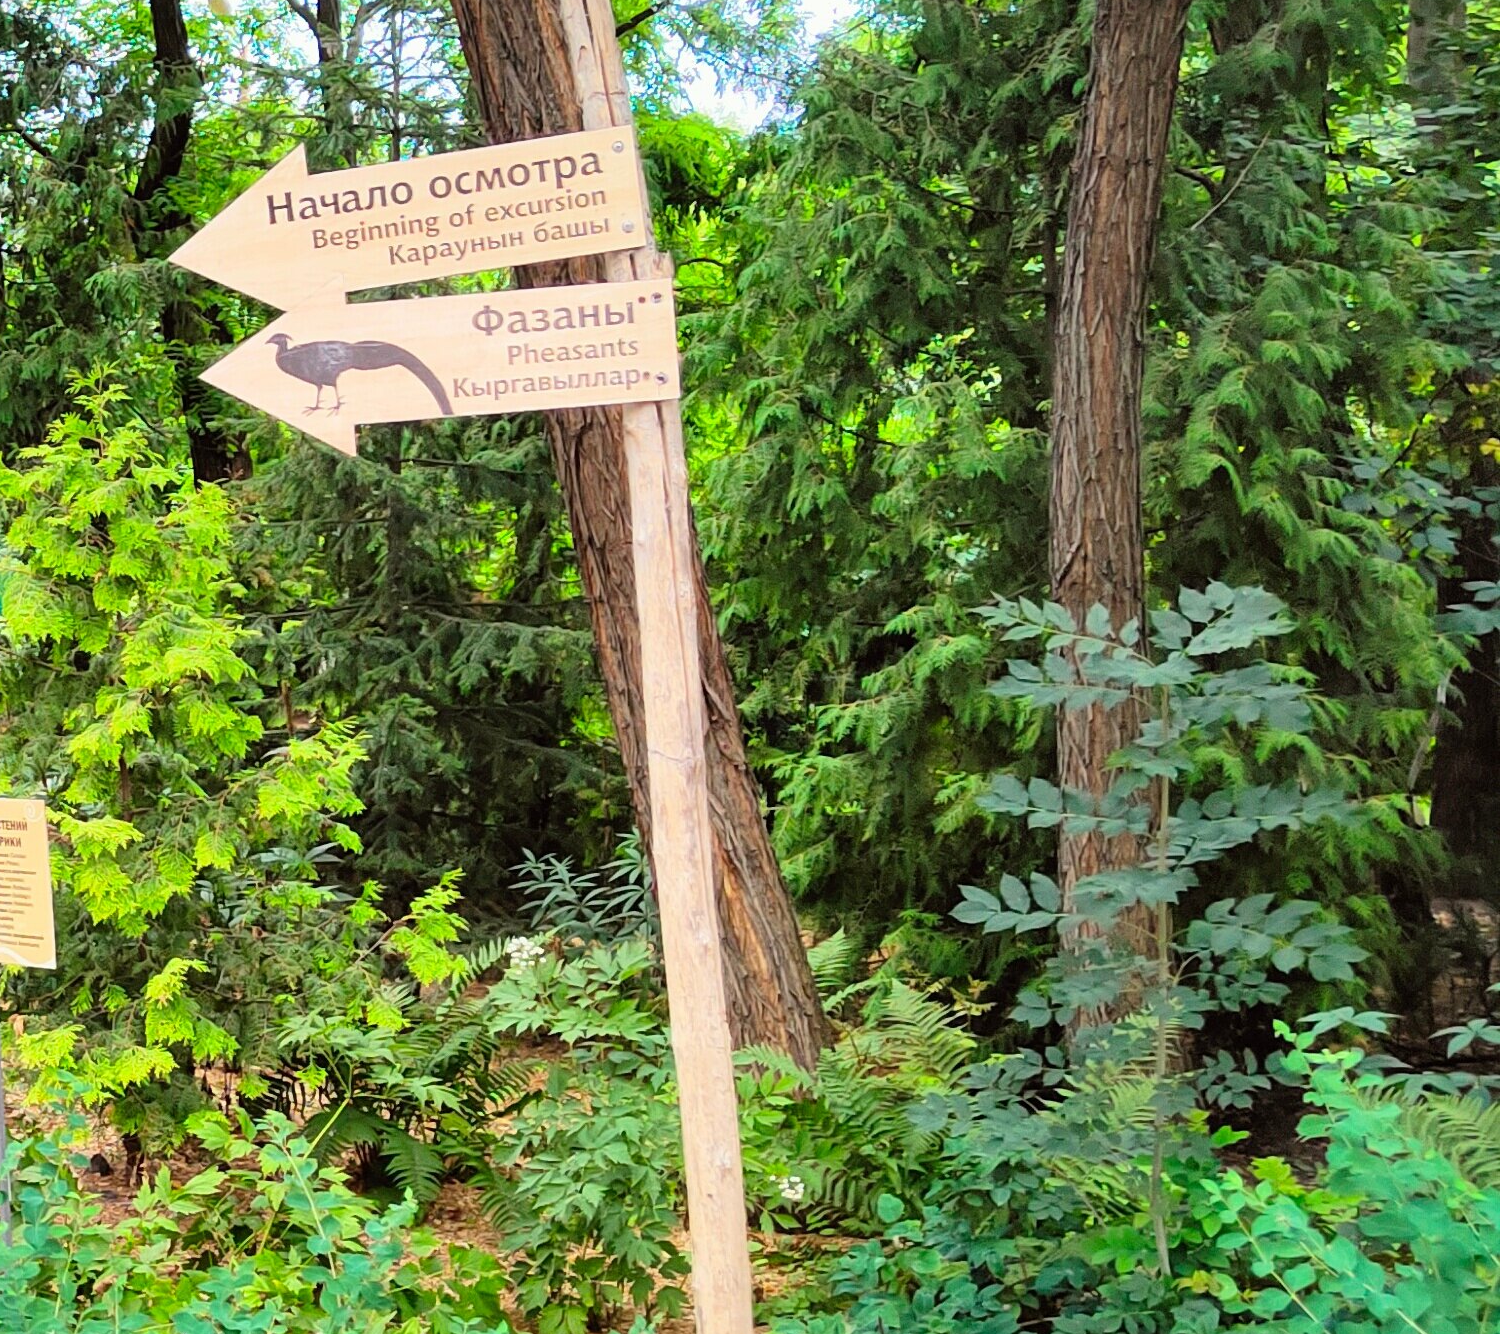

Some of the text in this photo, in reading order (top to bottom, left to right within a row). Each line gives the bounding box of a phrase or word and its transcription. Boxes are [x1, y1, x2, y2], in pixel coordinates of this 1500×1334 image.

[266, 152, 604, 225] Начало осмотра
[312, 188, 608, 250] Beginning of excursion
[388, 217, 610, 267] Караунын башы
[472, 301, 634, 335] Фазаны
[507, 336, 639, 365] Pheasants
[453, 369, 641, 399] Кыргавыллар
